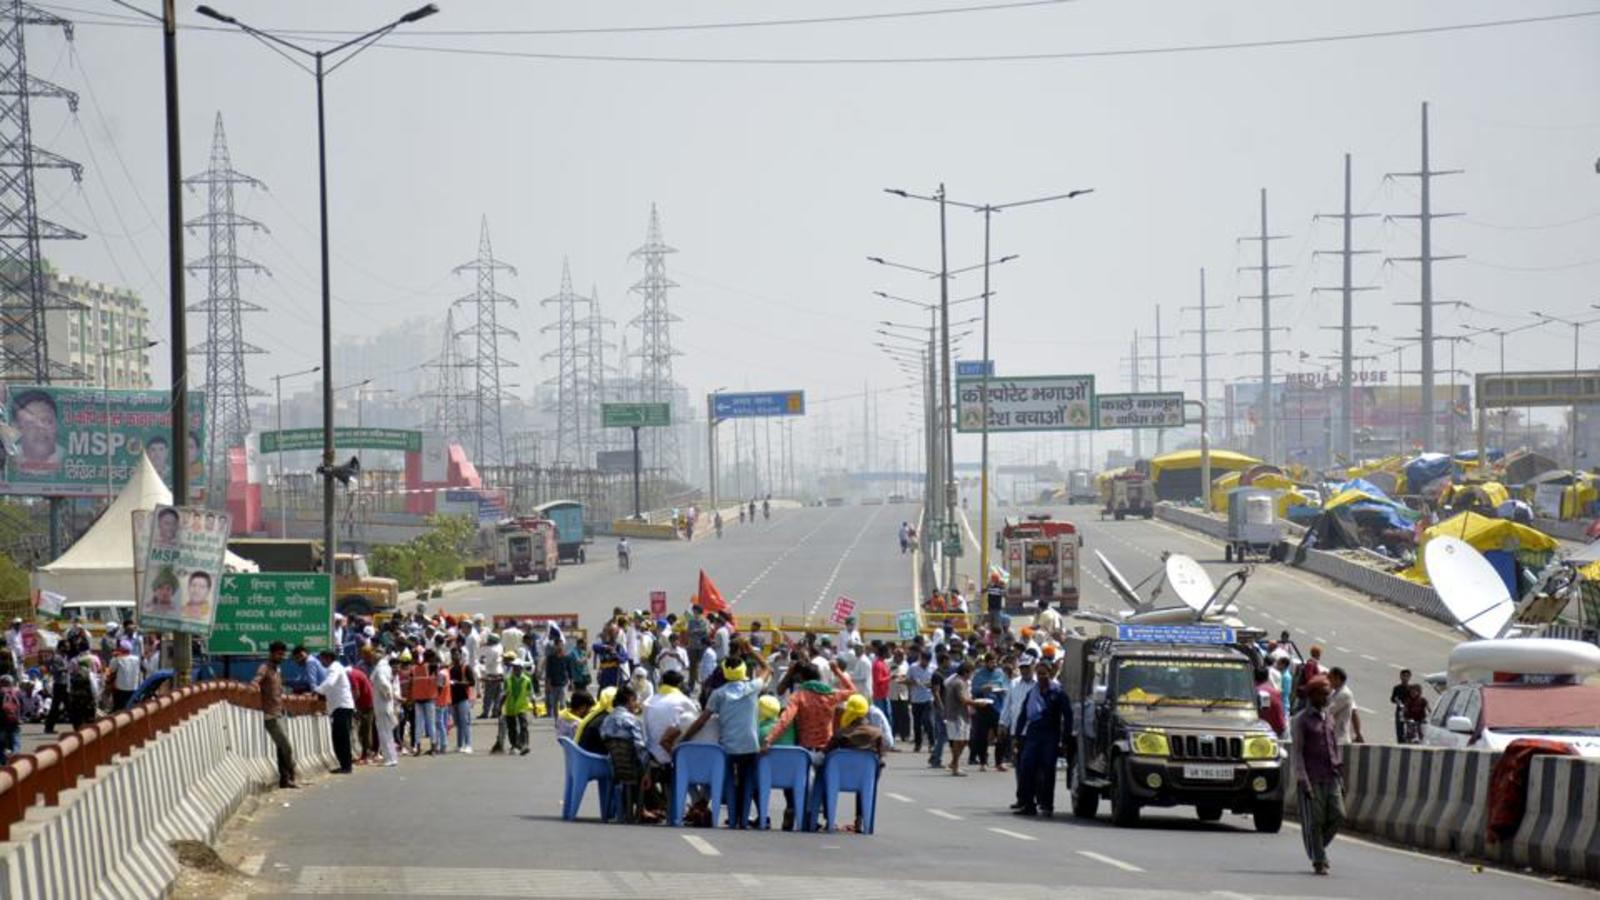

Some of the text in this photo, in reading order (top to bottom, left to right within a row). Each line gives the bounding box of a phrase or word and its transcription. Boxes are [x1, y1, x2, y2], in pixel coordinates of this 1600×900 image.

[1286, 372, 1329, 384] MEDIA
[68, 431, 125, 456] MSP
[151, 548, 180, 562] MSP
[235, 609, 302, 618] HINDON AIRPORT
[281, 623, 327, 632] GHAZIABAD
